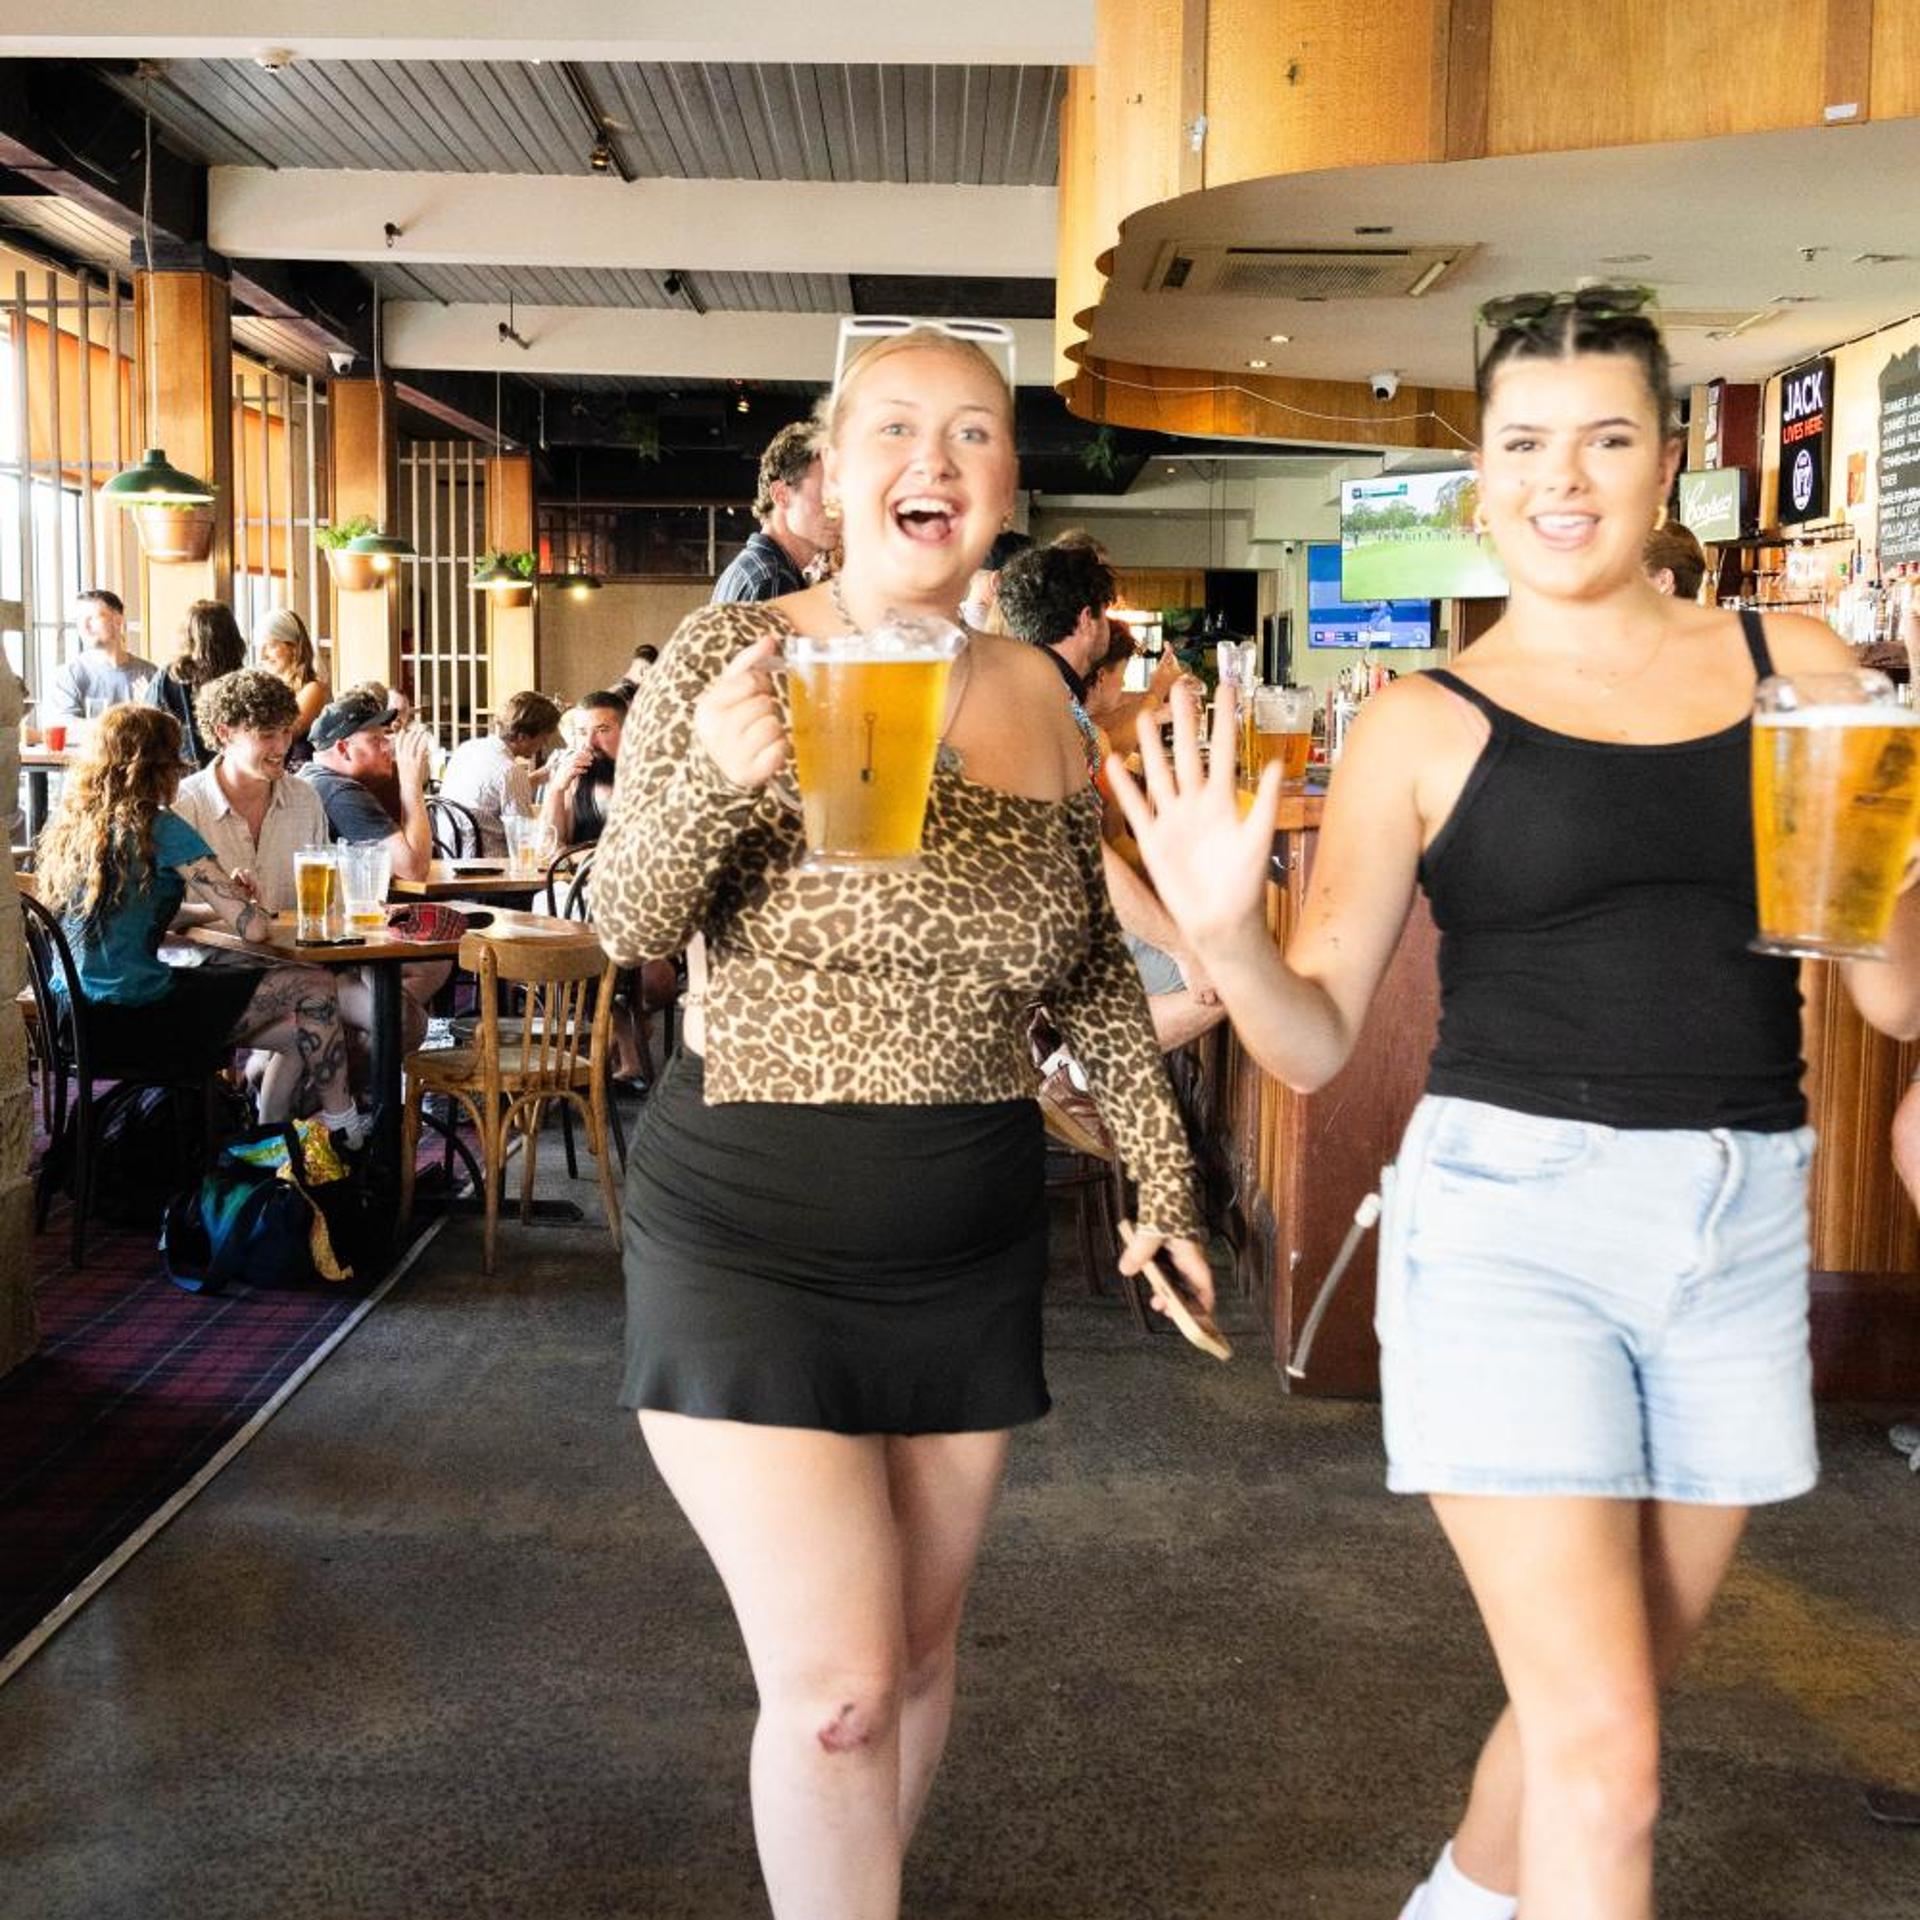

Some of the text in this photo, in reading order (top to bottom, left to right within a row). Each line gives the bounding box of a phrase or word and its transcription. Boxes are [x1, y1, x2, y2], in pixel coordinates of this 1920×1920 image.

[1783, 371, 1823, 421] JACK
[1783, 414, 1824, 444] LIVES HERE
